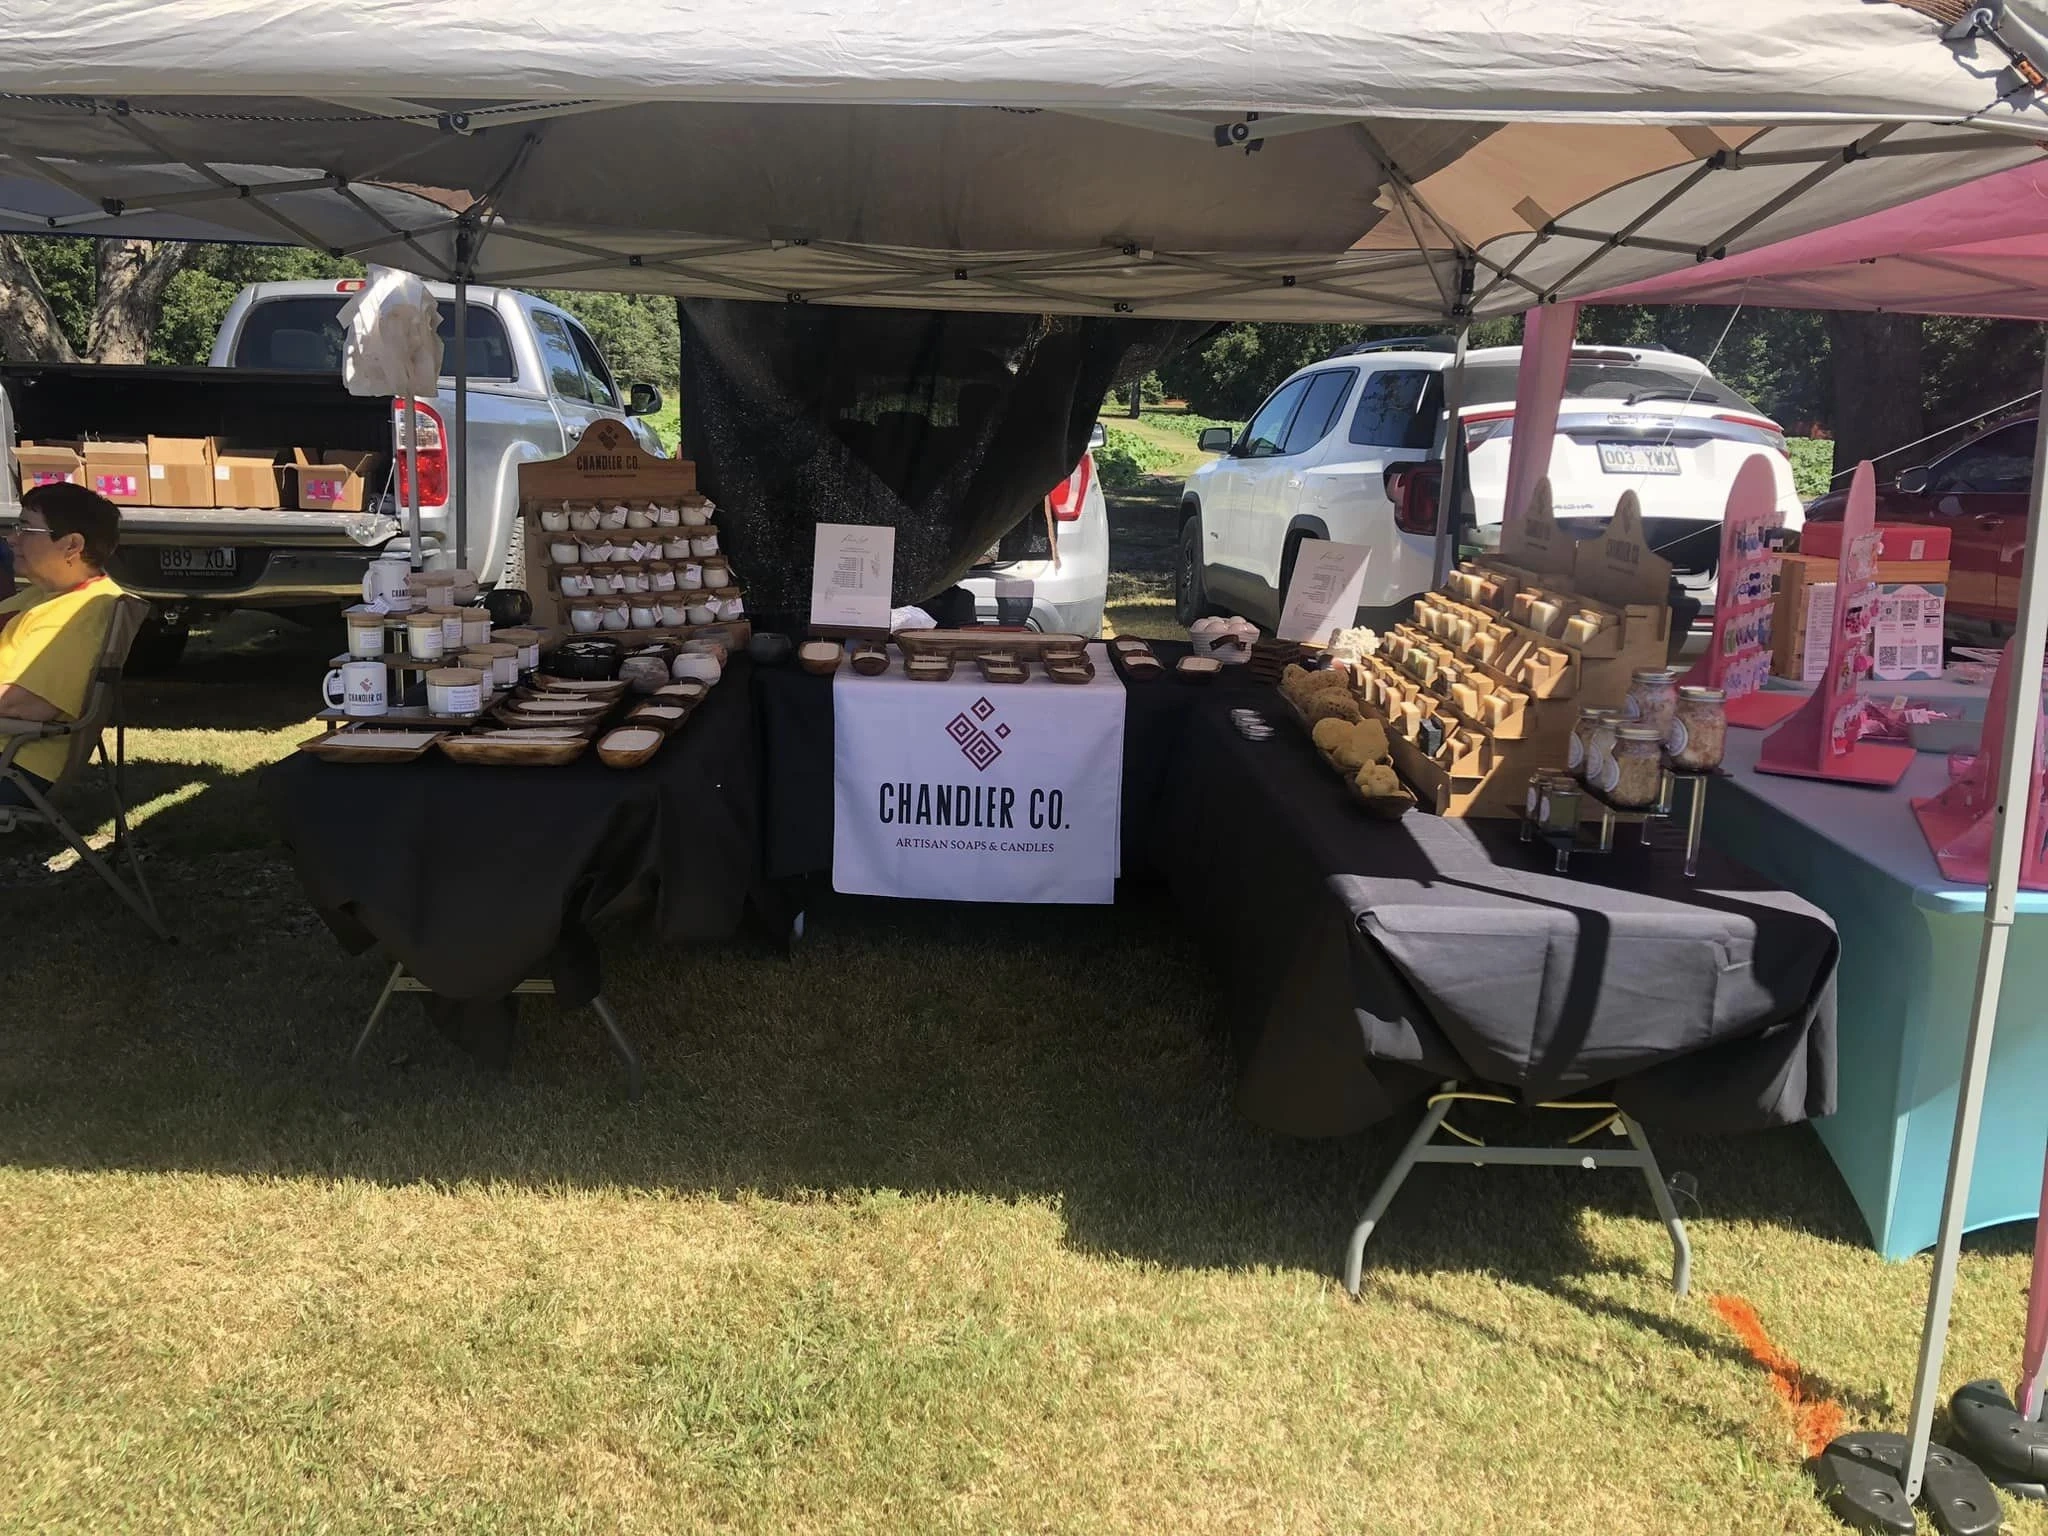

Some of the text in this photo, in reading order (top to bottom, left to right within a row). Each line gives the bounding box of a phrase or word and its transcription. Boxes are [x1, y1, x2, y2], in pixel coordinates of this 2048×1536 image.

[576, 455, 623, 471] CHANDLER
[162, 550, 193, 567] 889
[879, 782, 1070, 830] CHANDLER CO.
[896, 837, 1055, 853] ARTISAN SOAPS & CANDLES
